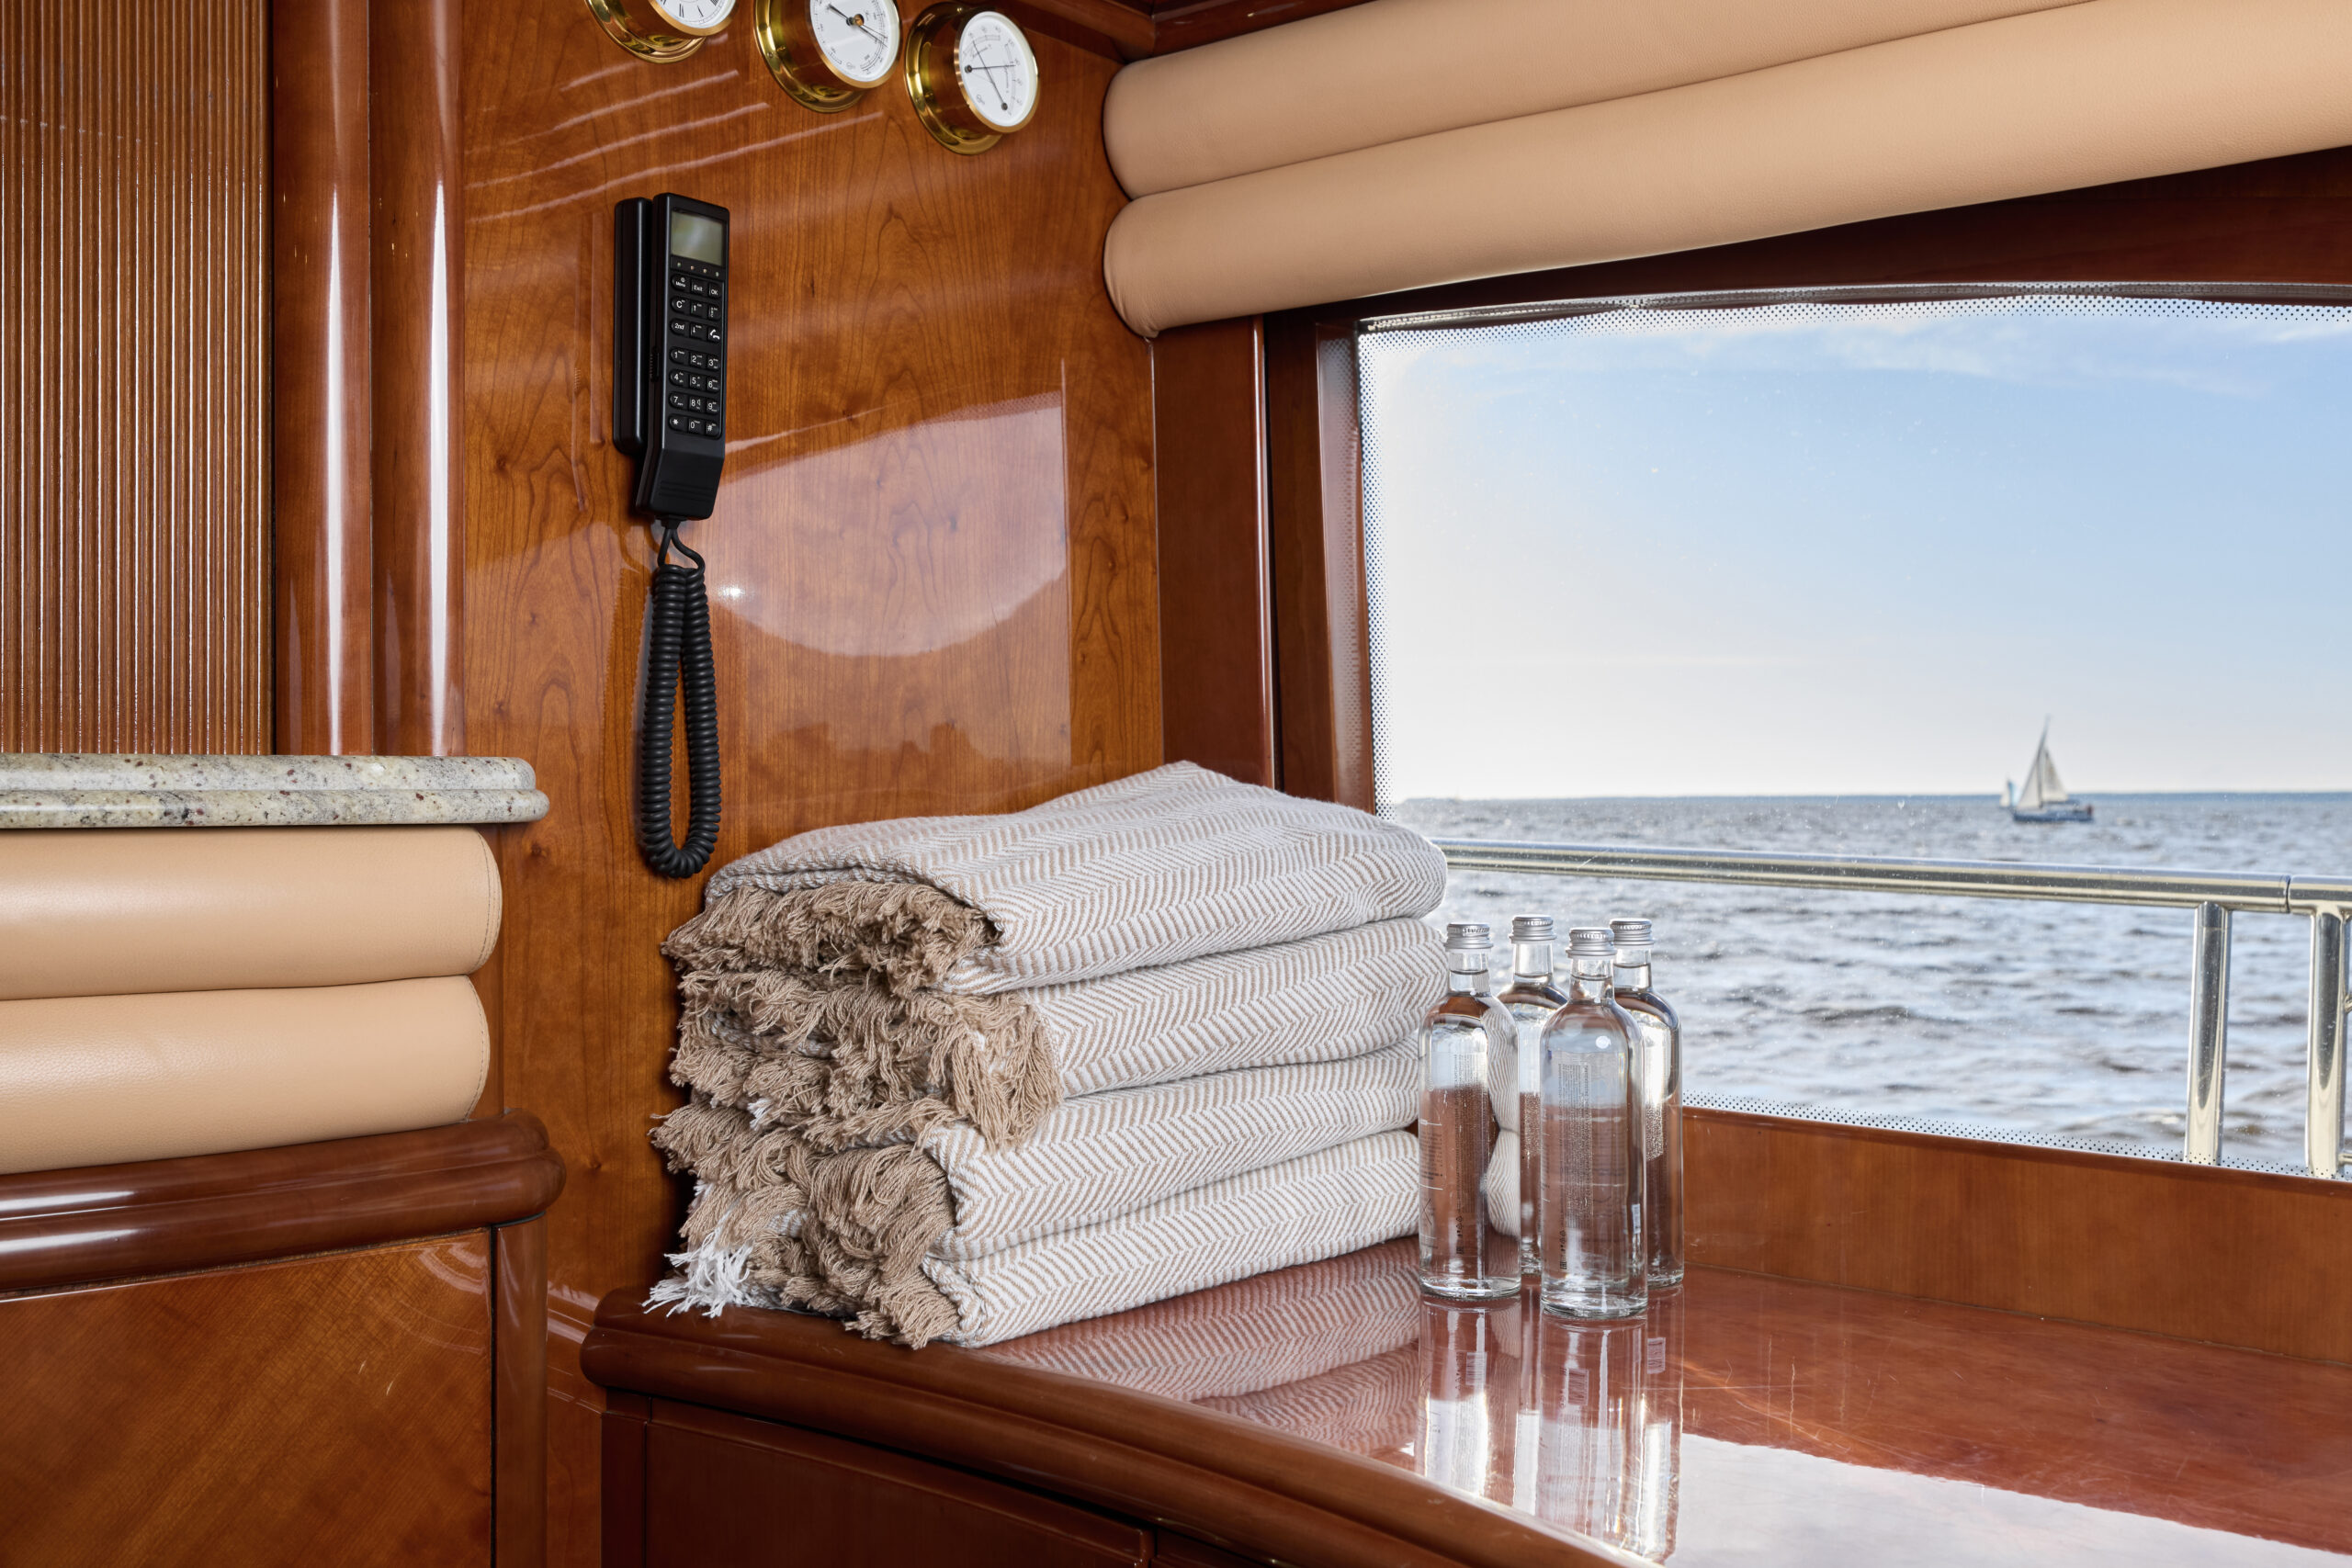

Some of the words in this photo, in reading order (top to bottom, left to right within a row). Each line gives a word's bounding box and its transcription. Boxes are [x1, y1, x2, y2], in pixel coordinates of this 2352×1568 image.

[676, 300, 682, 309] C
[691, 399, 695, 407] 8
[690, 421, 695, 429] 0
